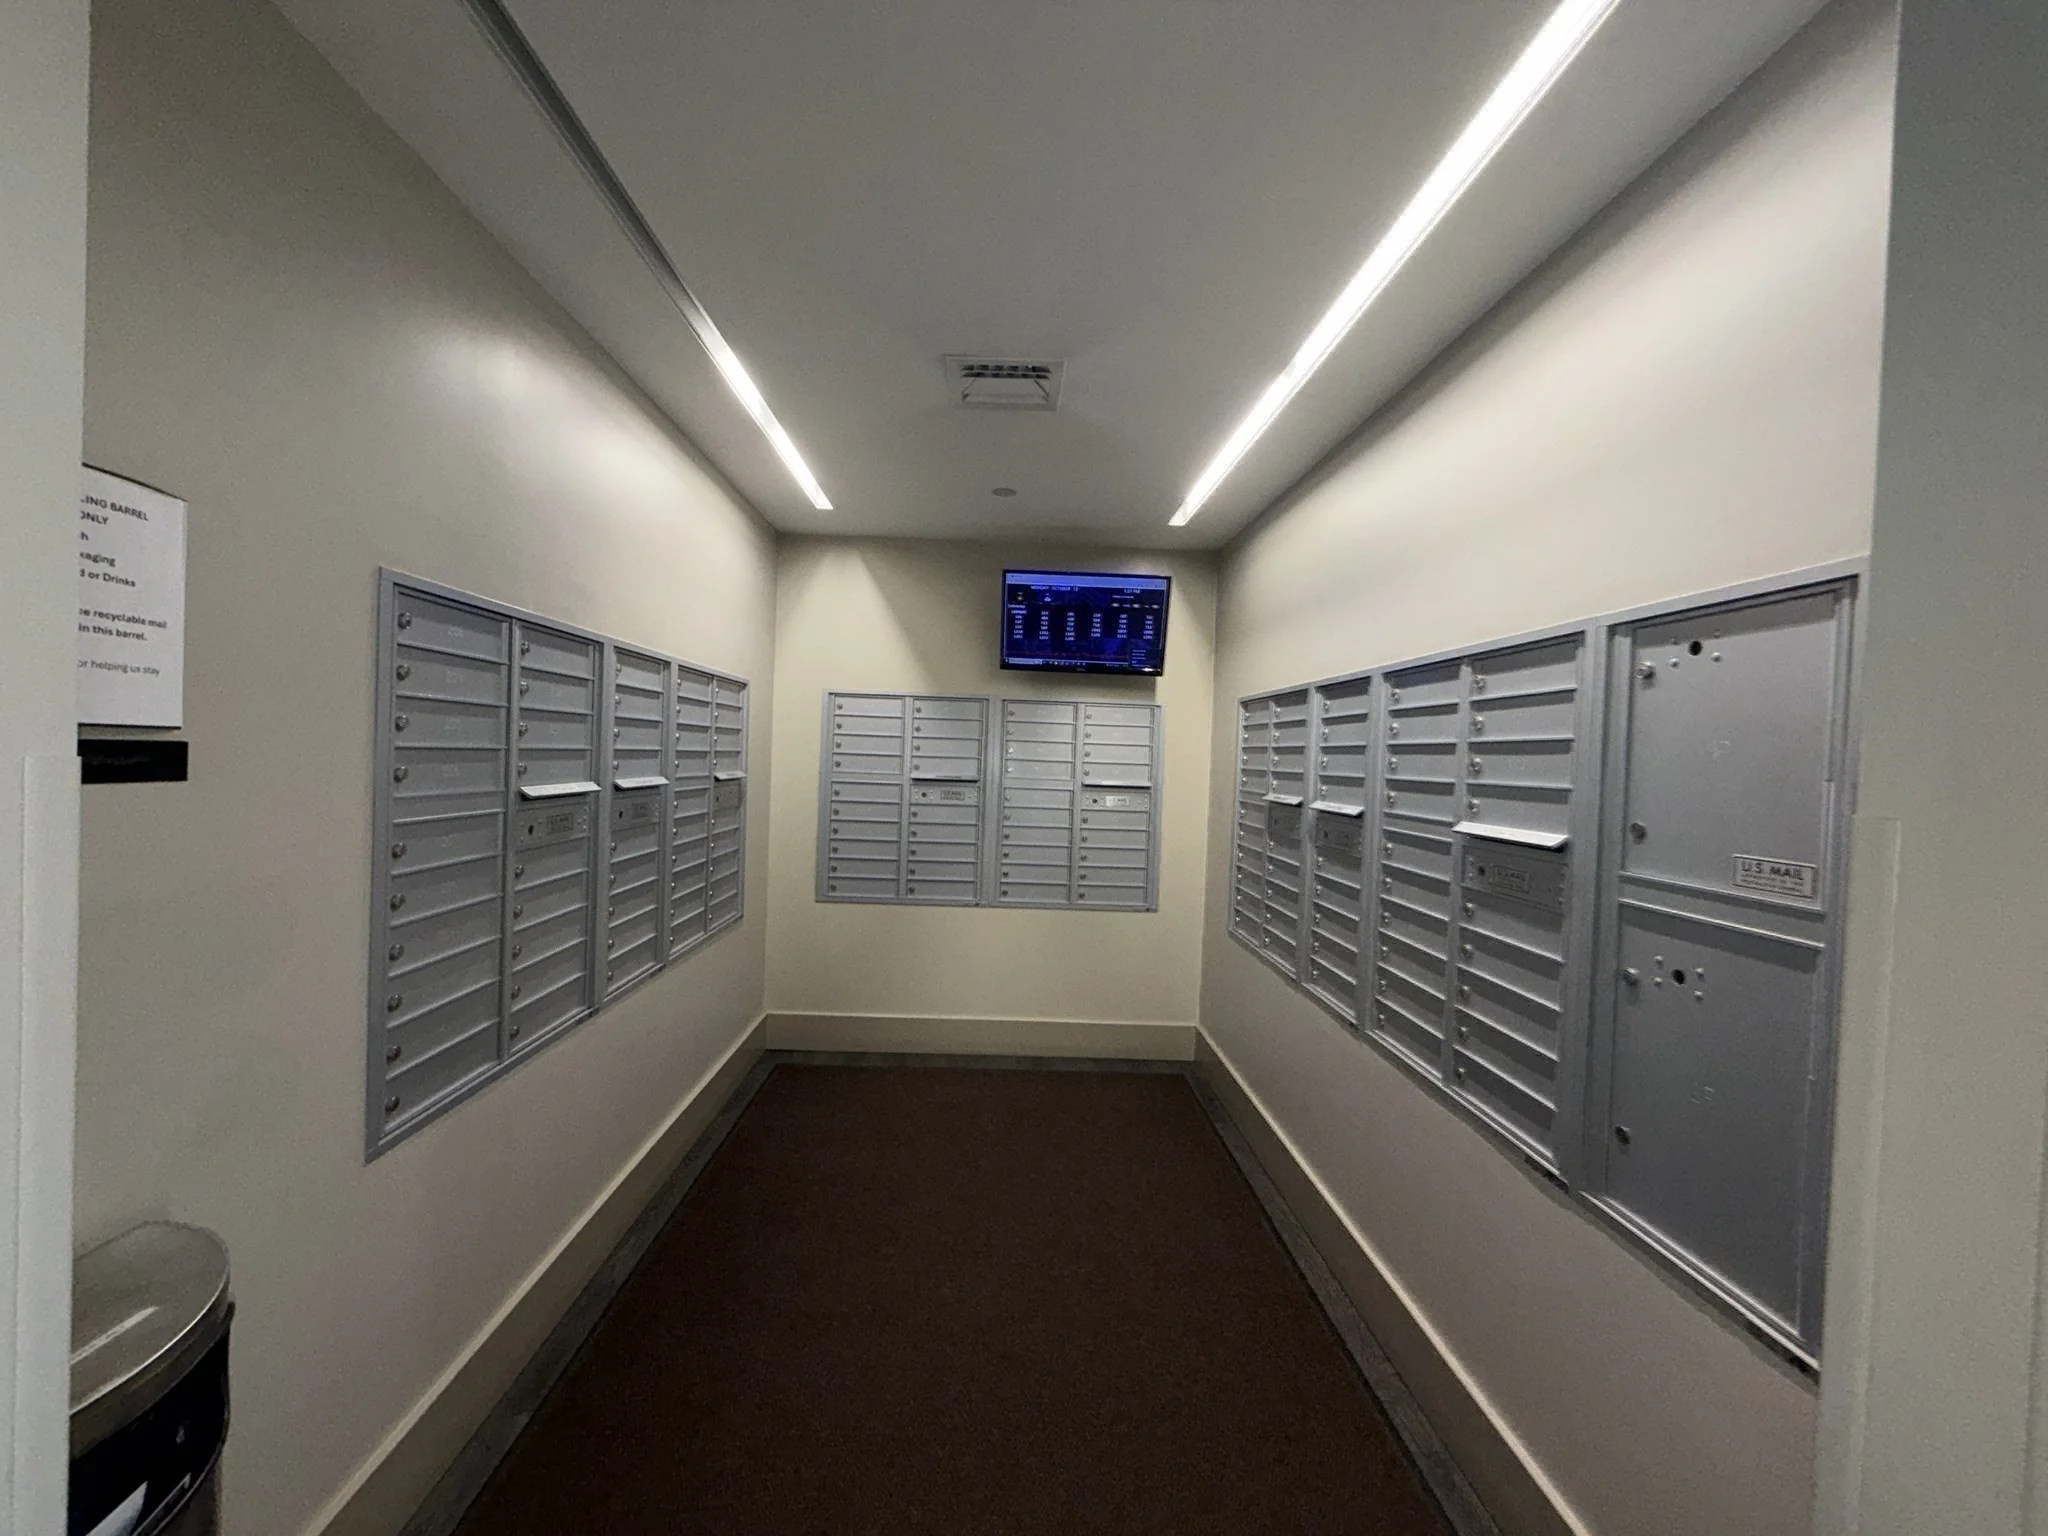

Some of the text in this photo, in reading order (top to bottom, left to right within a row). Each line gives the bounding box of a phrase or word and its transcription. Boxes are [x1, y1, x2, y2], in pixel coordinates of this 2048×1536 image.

[109, 501, 149, 522] BARREL
[87, 571, 100, 580] or
[102, 572, 136, 588] Drinks
[93, 609, 146, 626] recyclable
[147, 620, 167, 629] mail
[92, 625, 114, 636] this
[90, 659, 129, 674] helping
[130, 664, 141, 673] us
[142, 666, 160, 677] stay
[1769, 865, 1804, 881] MAIL
